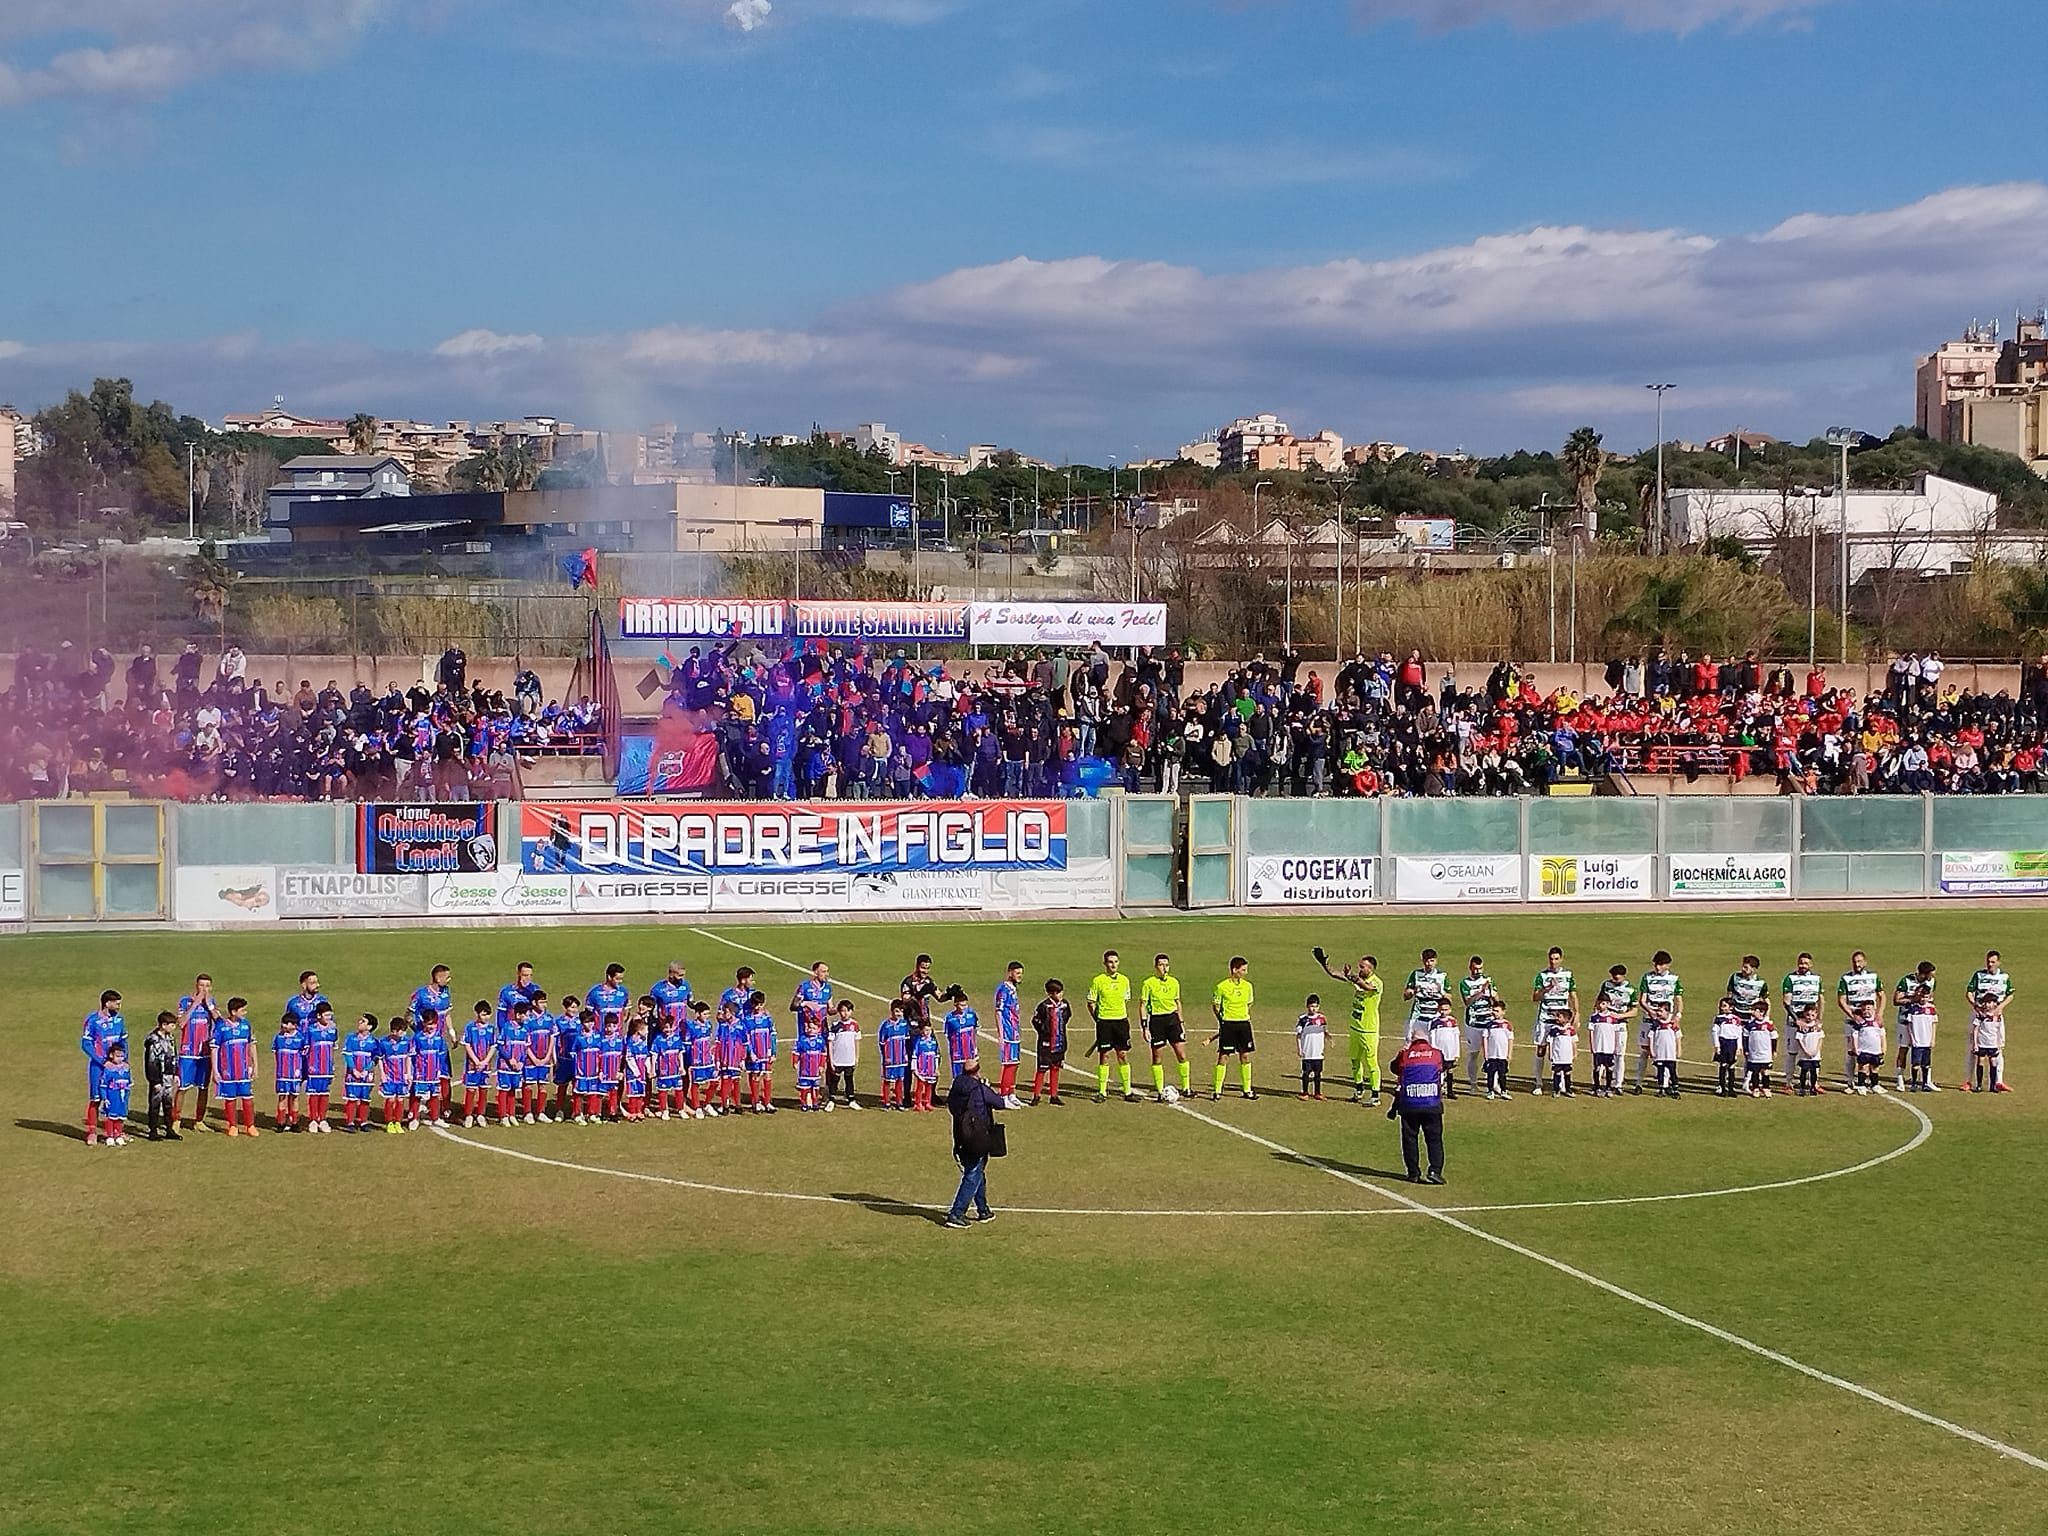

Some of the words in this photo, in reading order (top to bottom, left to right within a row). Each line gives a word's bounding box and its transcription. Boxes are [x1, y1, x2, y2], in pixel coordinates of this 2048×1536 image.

[626, 603, 783, 634] IRRIDUCIBILI
[797, 608, 860, 635] RIONE
[861, 608, 964, 637] SALINELLE
[975, 608, 991, 624] A
[996, 608, 1061, 629] Sostegno
[1067, 611, 1083, 625] di
[1087, 615, 1116, 625] una
[1120, 609, 1161, 628] Fede!
[396, 806, 430, 819] rione
[379, 812, 476, 846] Quattro
[580, 813, 628, 866] DI
[643, 813, 824, 866] PADRE
[837, 813, 882, 864] IN
[897, 811, 1050, 863] FIGLIO
[395, 842, 460, 872] Canti
[1282, 859, 1372, 881] COGEKAT
[1447, 865, 1494, 877] GEALAN
[1583, 859, 1618, 875] Luigi
[1673, 868, 1752, 880] BIOCHEMICAL
[1753, 868, 1786, 880] AGRO
[286, 876, 396, 896] ETNAPOLIS
[598, 882, 709, 897] CIBIESSE
[738, 881, 847, 895] CIBIESSE
[1283, 885, 1373, 899] distributori
[1583, 876, 1639, 890] Floridia
